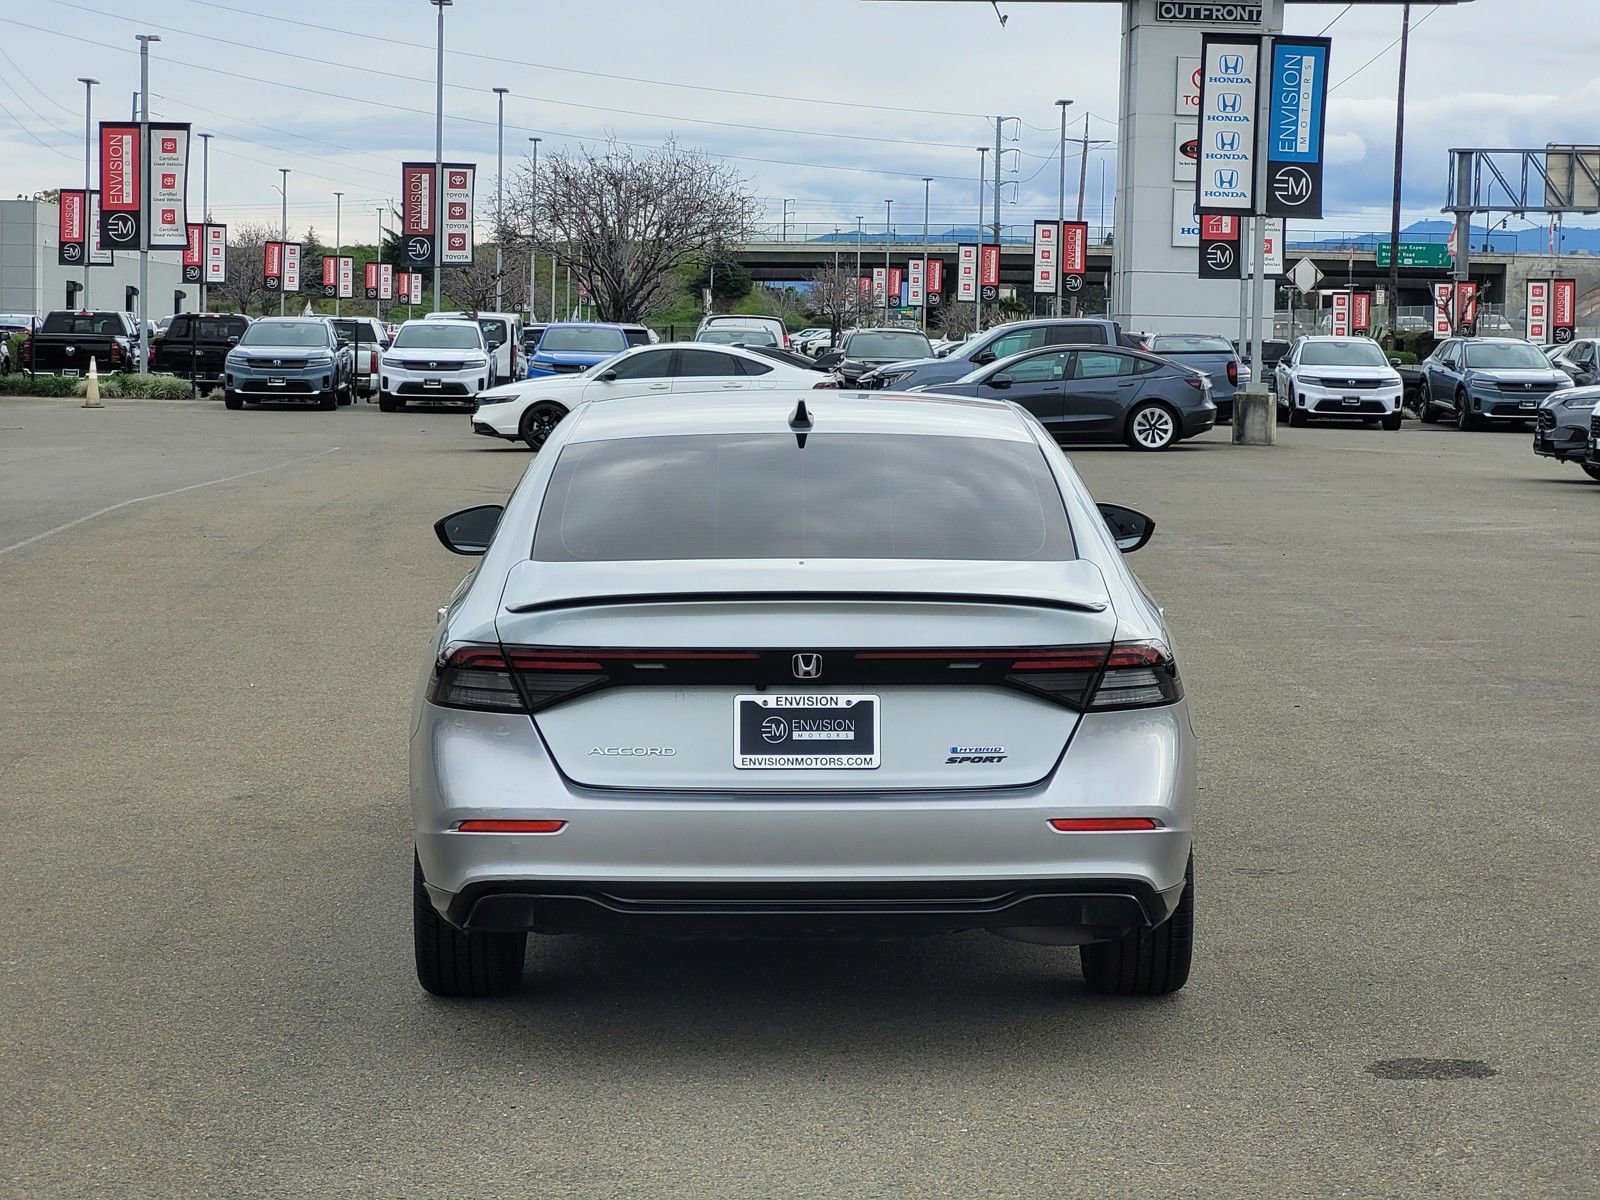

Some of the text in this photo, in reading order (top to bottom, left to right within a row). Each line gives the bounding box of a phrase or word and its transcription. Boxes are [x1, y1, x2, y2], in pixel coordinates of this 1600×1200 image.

[1279, 54, 1301, 152] ENVISION
[1300, 64, 1312, 144] MOTORS
[110, 134, 122, 204] ENVISION
[410, 174, 421, 230] ENVISION
[65, 196, 73, 238] ENVISION
[776, 696, 838, 707] ENVISION
[792, 720, 855, 731] ENVISION
[588, 746, 676, 756] ACCORD
[741, 757, 873, 766] ENVISIONMOTORS.COM
[944, 756, 1008, 764] SPORT
